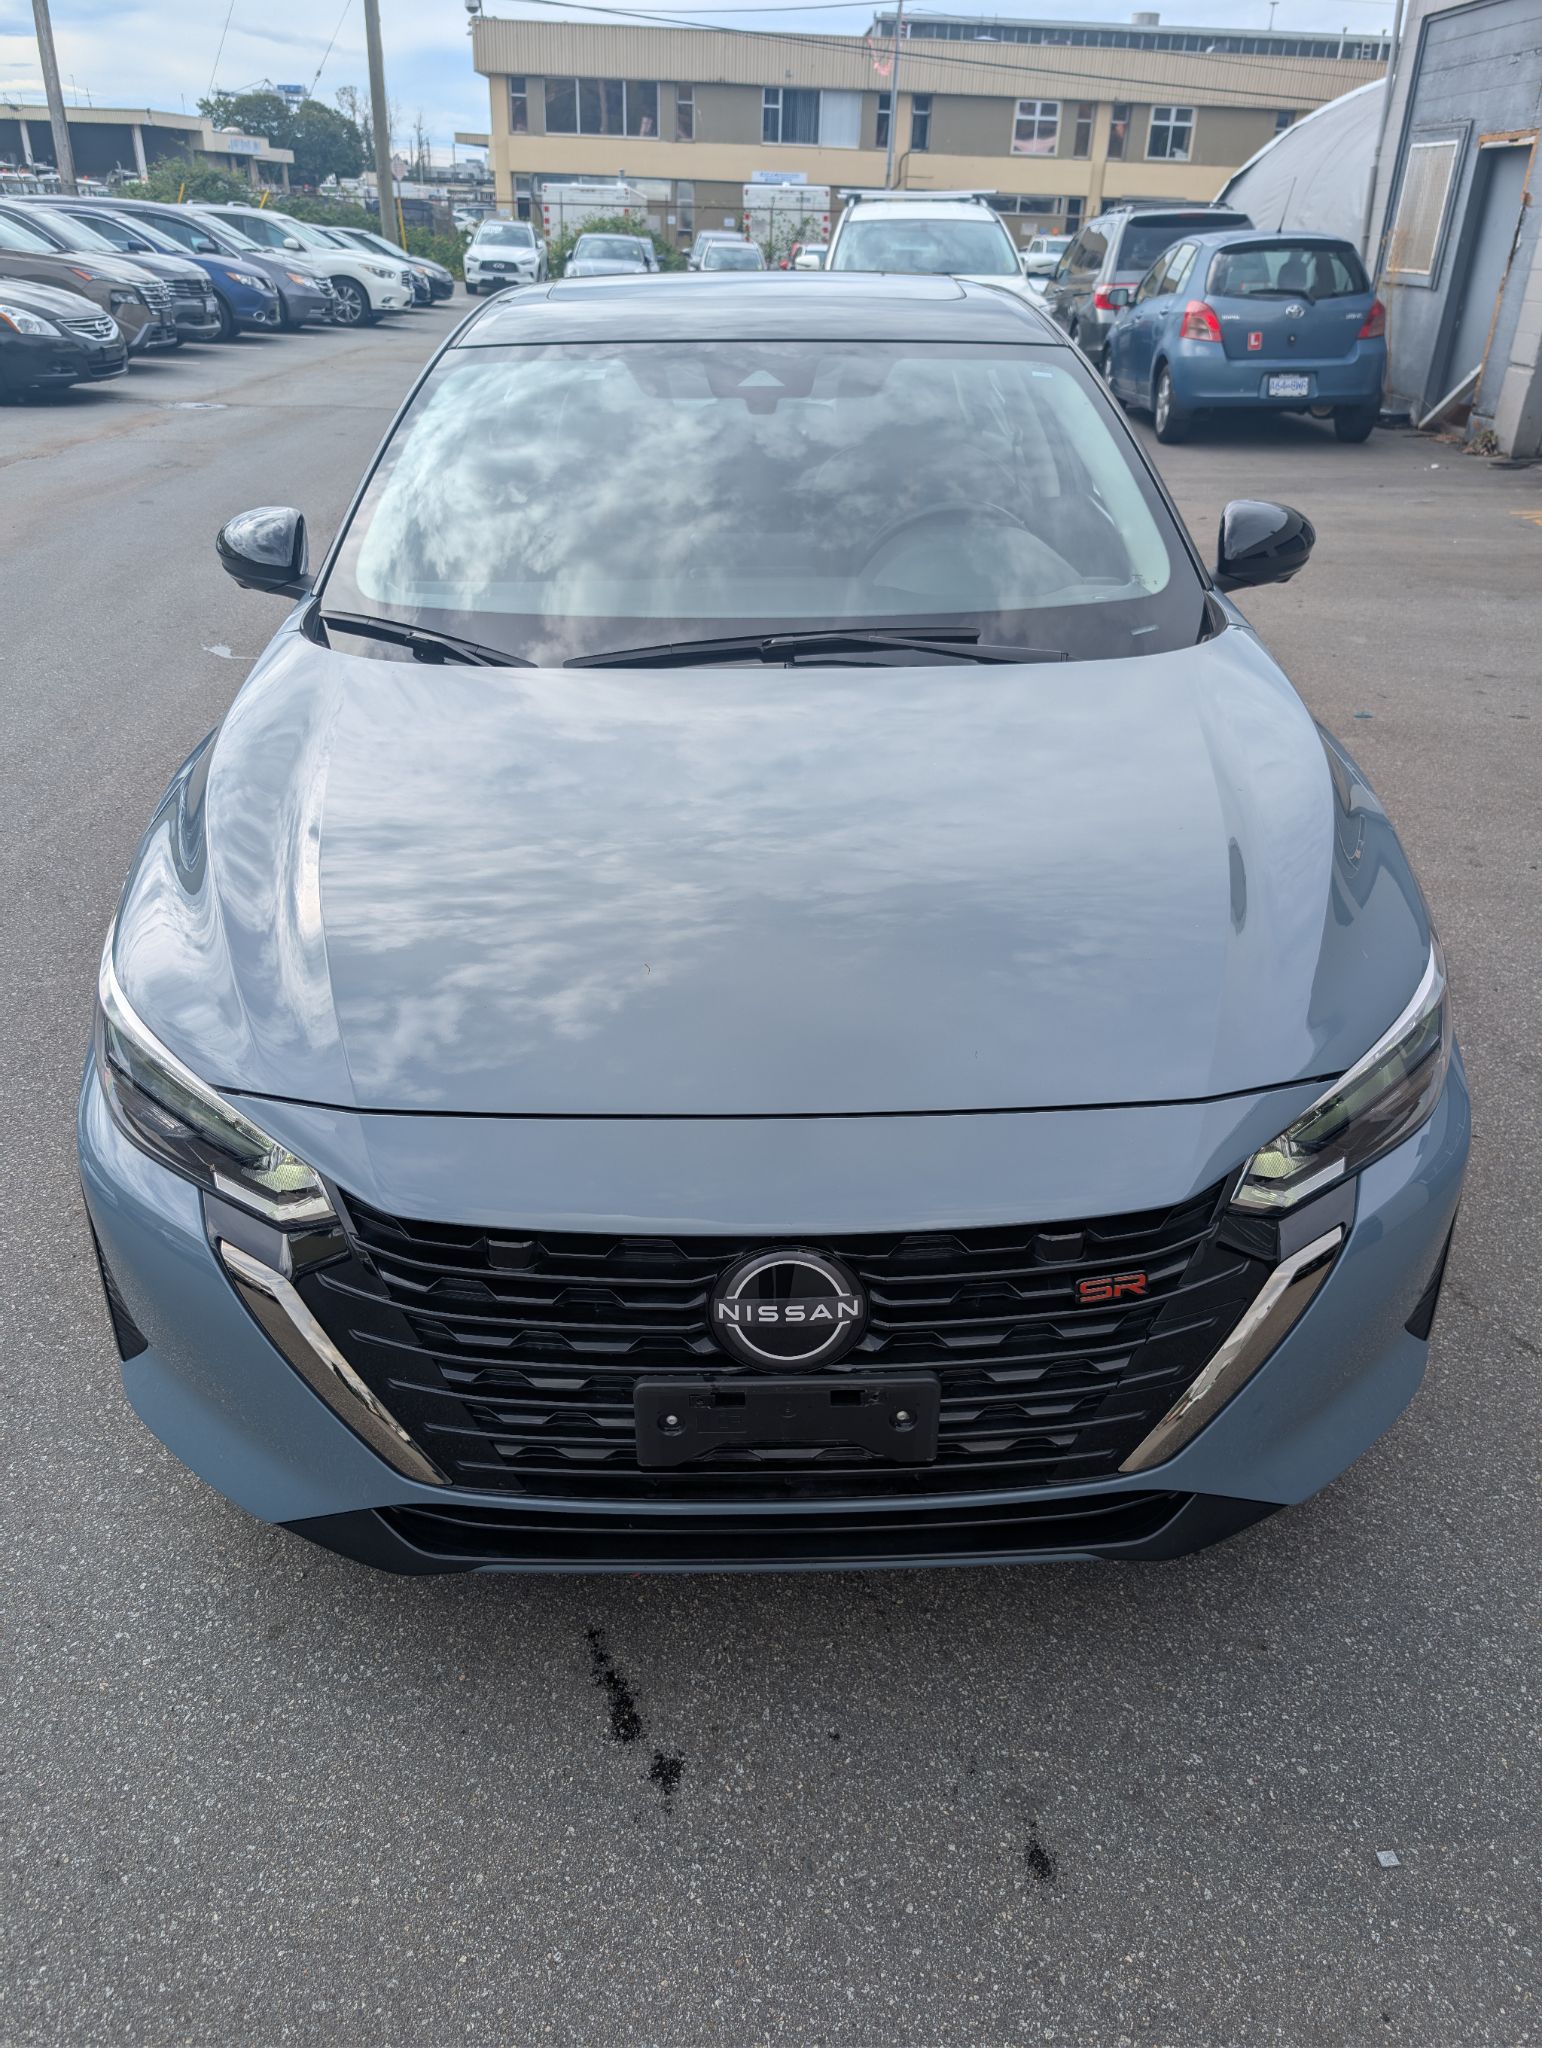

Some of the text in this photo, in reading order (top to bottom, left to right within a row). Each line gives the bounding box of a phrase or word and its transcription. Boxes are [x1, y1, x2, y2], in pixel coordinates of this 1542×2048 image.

[1250, 333, 1260, 346] L
[1079, 1273, 1148, 1303] SR
[718, 1299, 859, 1322] NISSAN
